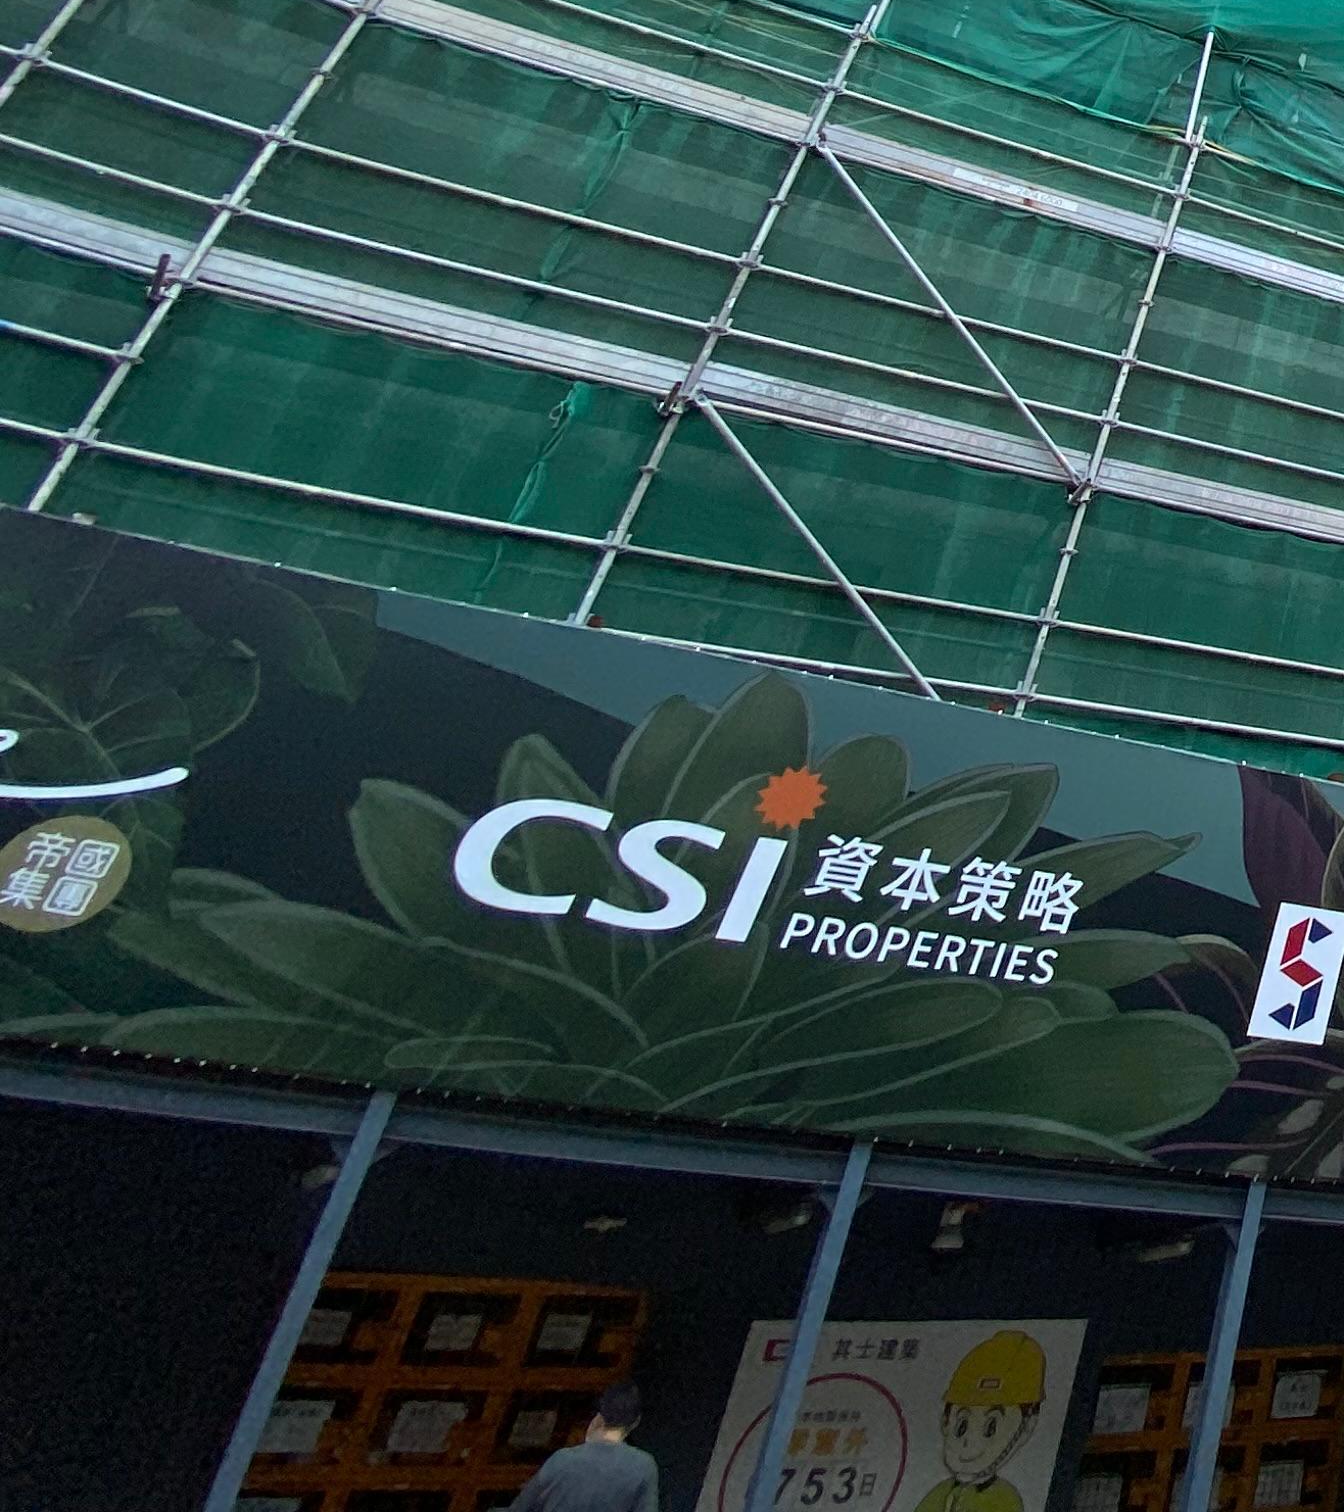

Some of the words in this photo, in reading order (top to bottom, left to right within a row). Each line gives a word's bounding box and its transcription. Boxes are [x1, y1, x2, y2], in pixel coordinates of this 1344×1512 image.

[804, 833, 1085, 936] 資本策略
[779, 912, 1059, 986] PROPERTIES
